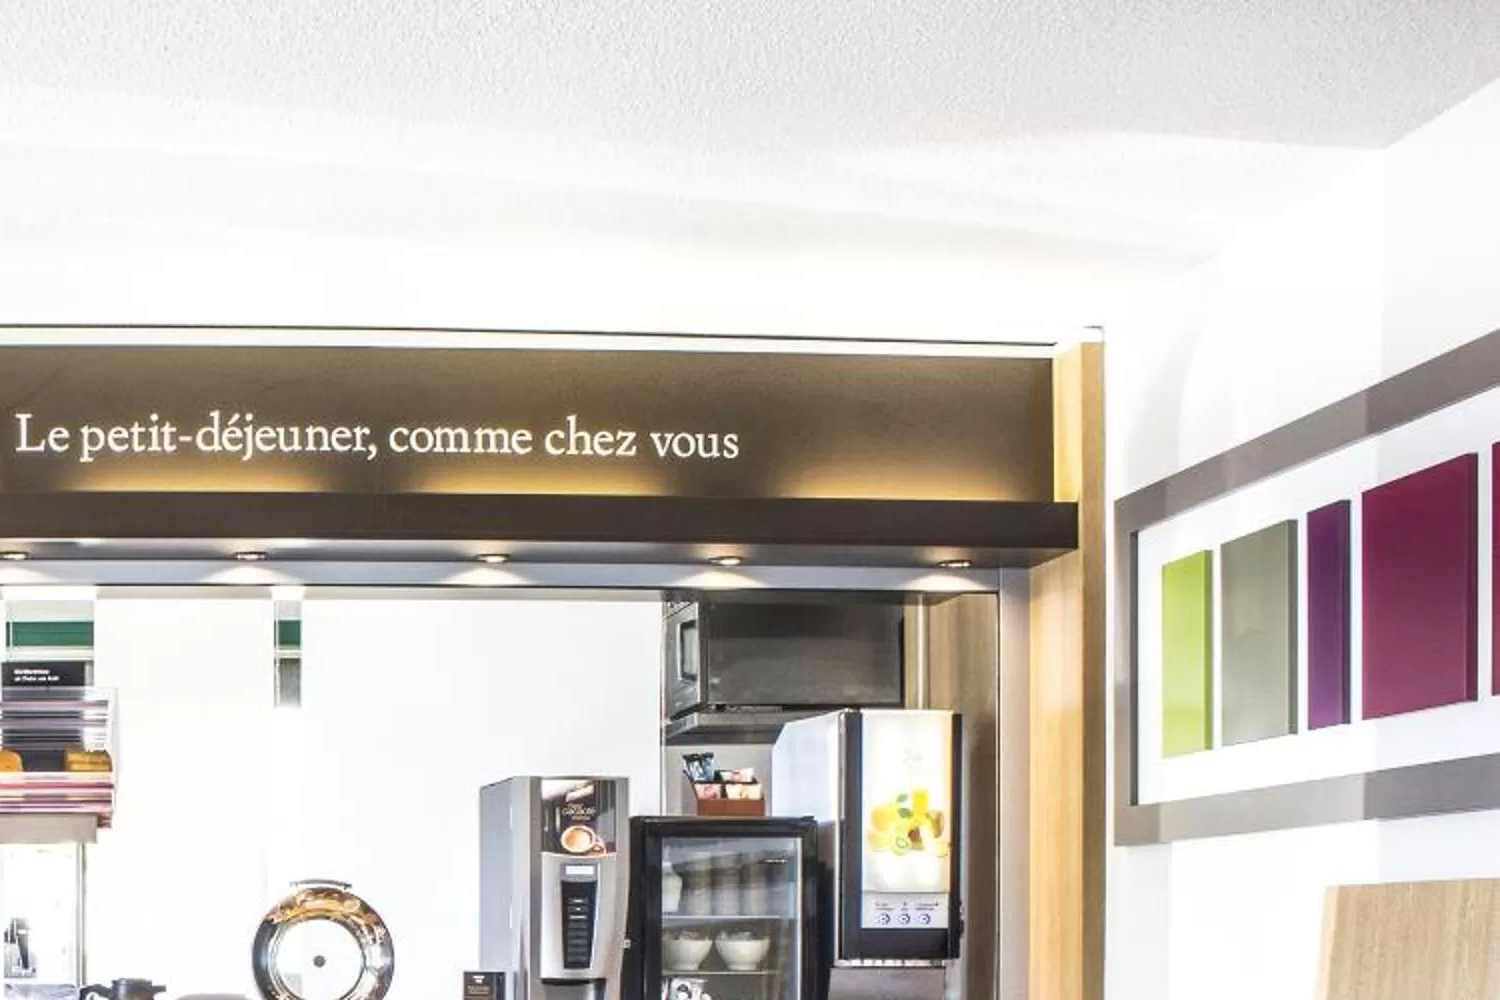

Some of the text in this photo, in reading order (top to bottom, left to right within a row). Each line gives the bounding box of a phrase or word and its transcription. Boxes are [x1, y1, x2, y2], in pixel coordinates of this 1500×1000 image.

[14, 410, 740, 462] Le petit-déjeuner, comme chez vous
